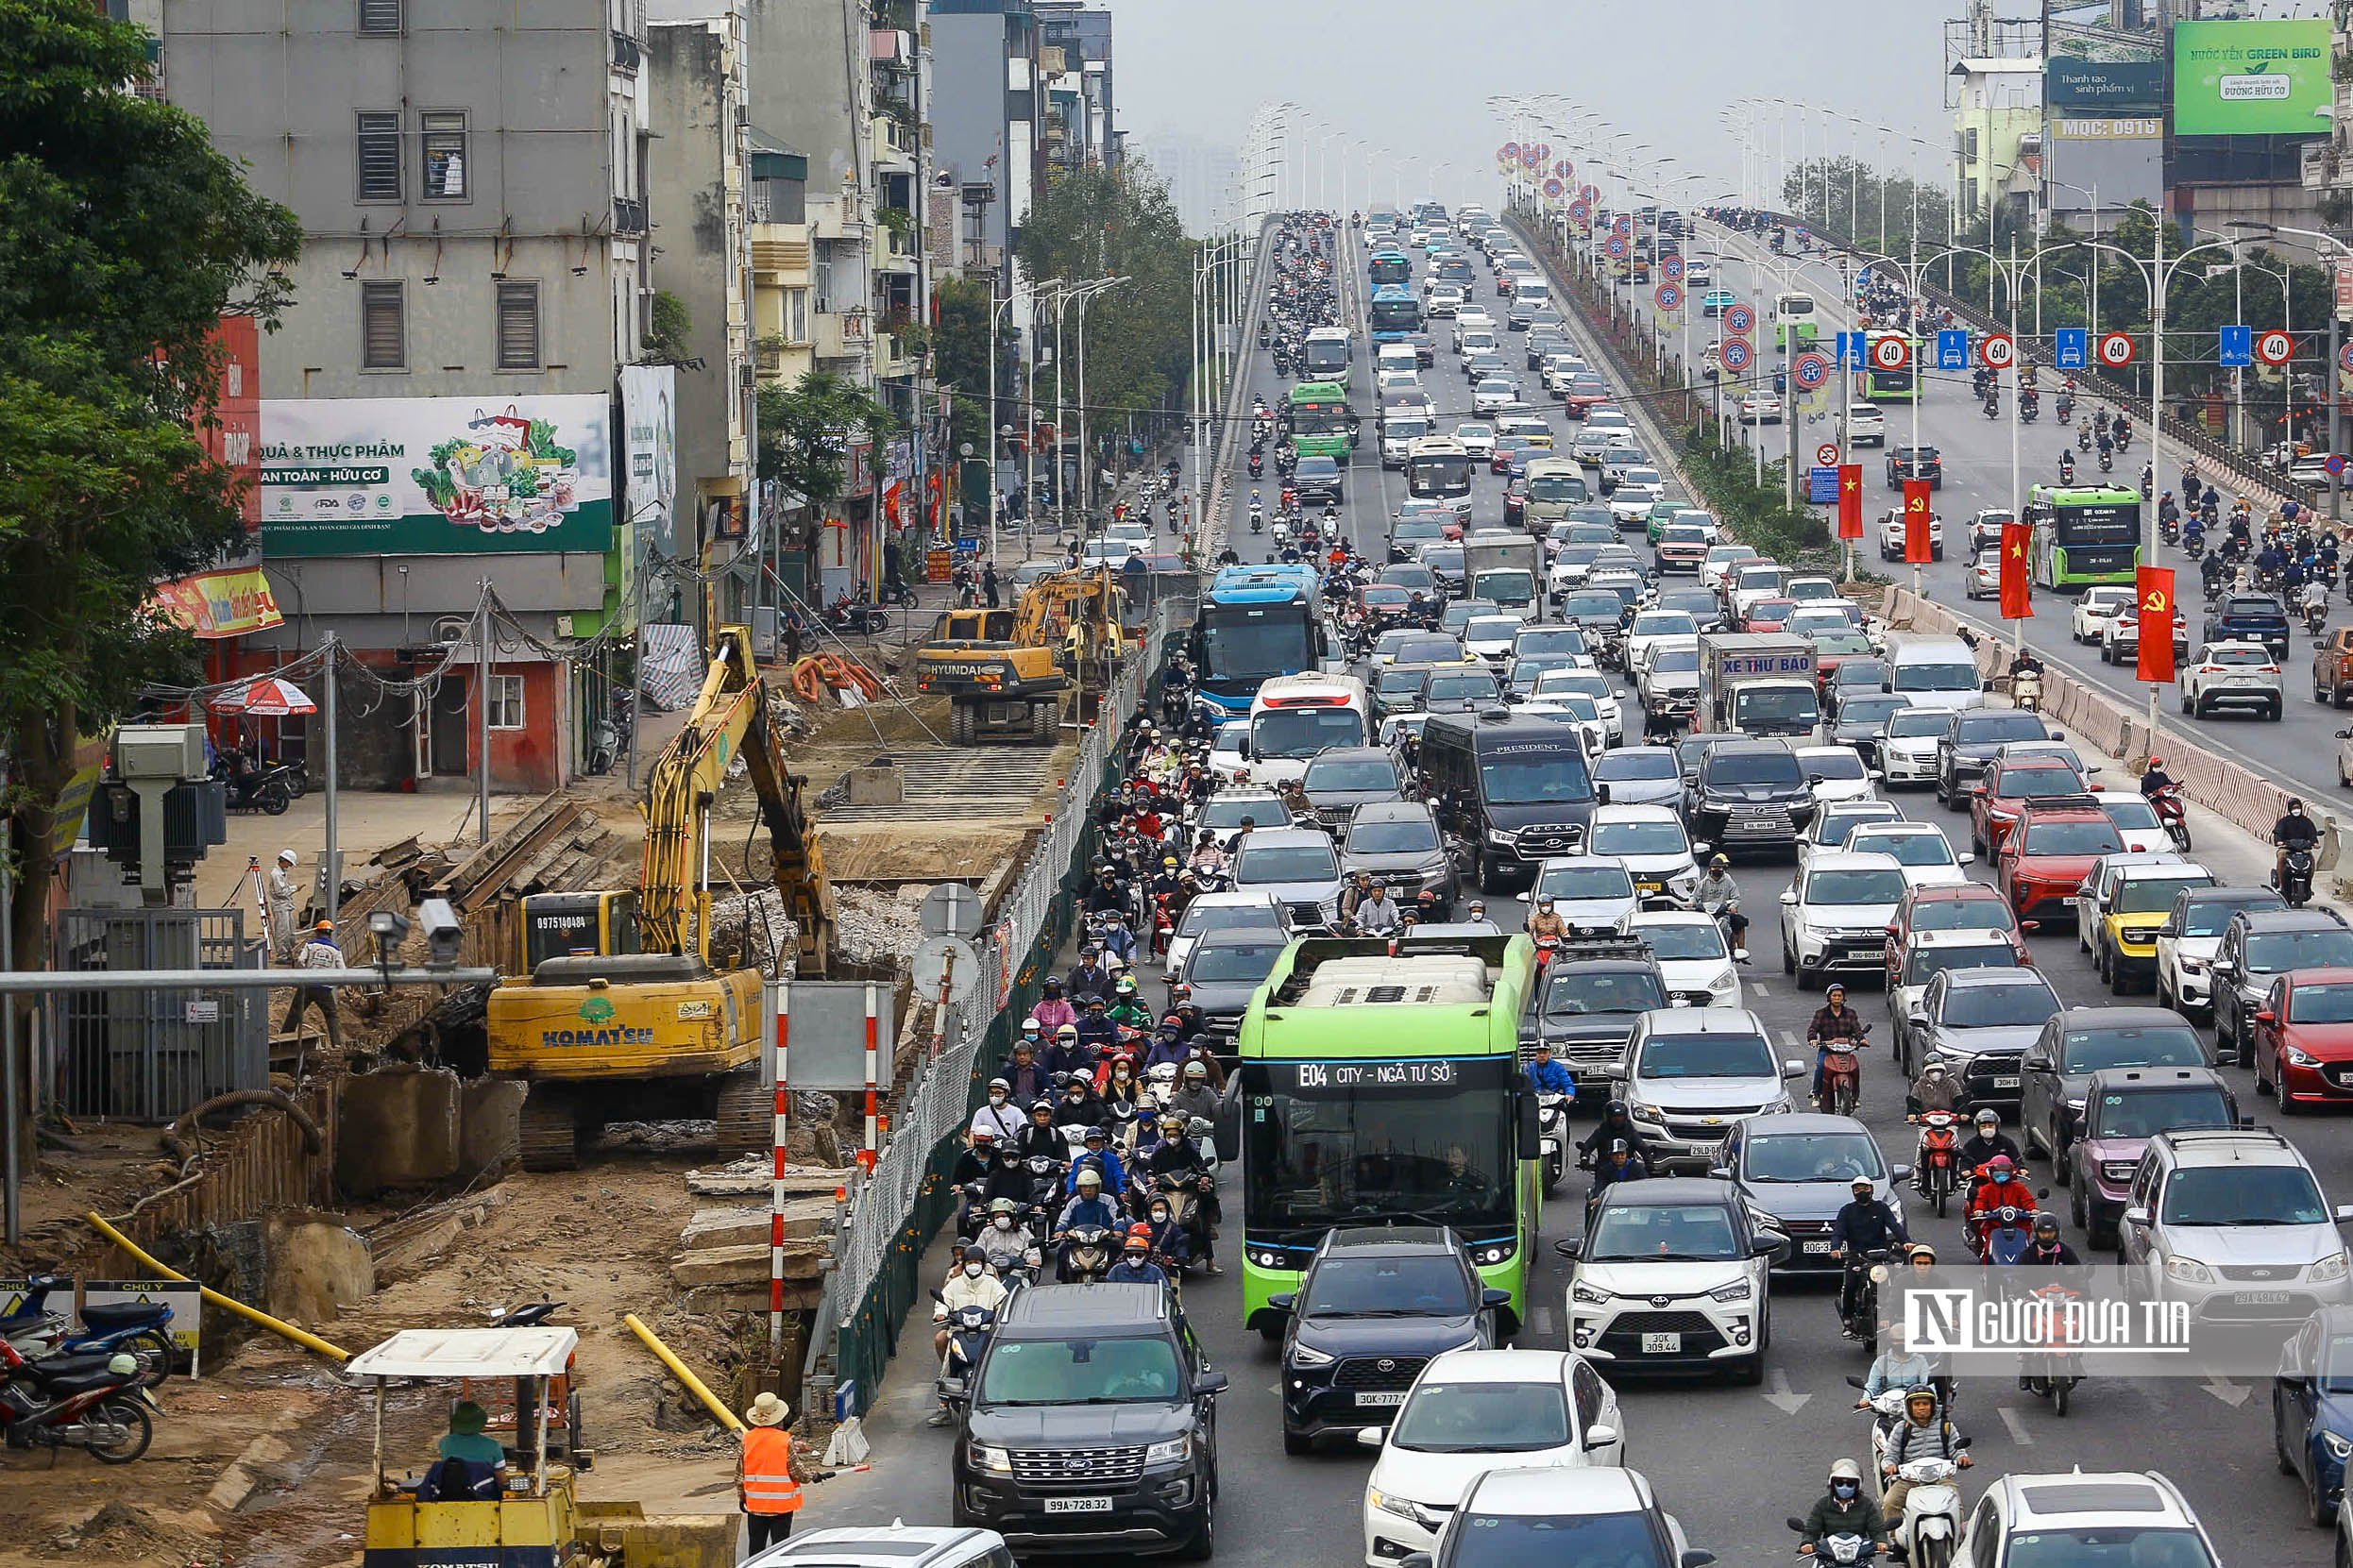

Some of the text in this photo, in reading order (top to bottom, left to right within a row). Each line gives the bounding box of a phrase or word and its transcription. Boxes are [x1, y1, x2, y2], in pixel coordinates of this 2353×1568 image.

[2247, 48, 2288, 59] GREEN
[2292, 47, 2321, 59] BIRD
[2062, 75, 2090, 84] Thanh
[2075, 85, 2095, 93] sinh
[2062, 120, 2108, 136] MQC:
[1883, 346, 1898, 361] 60
[1991, 344, 2006, 359] 60
[2109, 342, 2124, 358] 60
[2268, 339, 2284, 356] 40
[293, 447, 303, 458] &
[306, 444, 352, 463] THỰC
[355, 439, 405, 458] PHẨM
[261, 472, 280, 482] AN
[282, 469, 320, 482] TOÀN
[330, 468, 360, 481] HỮU
[362, 468, 382, 481] CƠ
[931, 664, 981, 677] HYUNDAI
[1723, 661, 1742, 673] XE
[1747, 657, 1775, 673] THƯ
[1497, 744, 1560, 753] PRESIDENT
[536, 916, 585, 930] 0975140484
[543, 1025, 653, 1048] KOMATSU
[1299, 1064, 1328, 1087] E04
[1336, 1067, 1363, 1083] CITY
[1377, 1062, 1407, 1083] NGÃ
[1410, 1063, 1428, 1082] TƯ
[1430, 1060, 1450, 1082] SỞ
[122, 1280, 163, 1291] CHÚ Ý
[1652, 1334, 1668, 1343] 30K
[1647, 1342, 1677, 1353] 309.44
[1068, 1458, 1088, 1470] Ford
[1050, 1499, 1107, 1511] 99A-728.32
